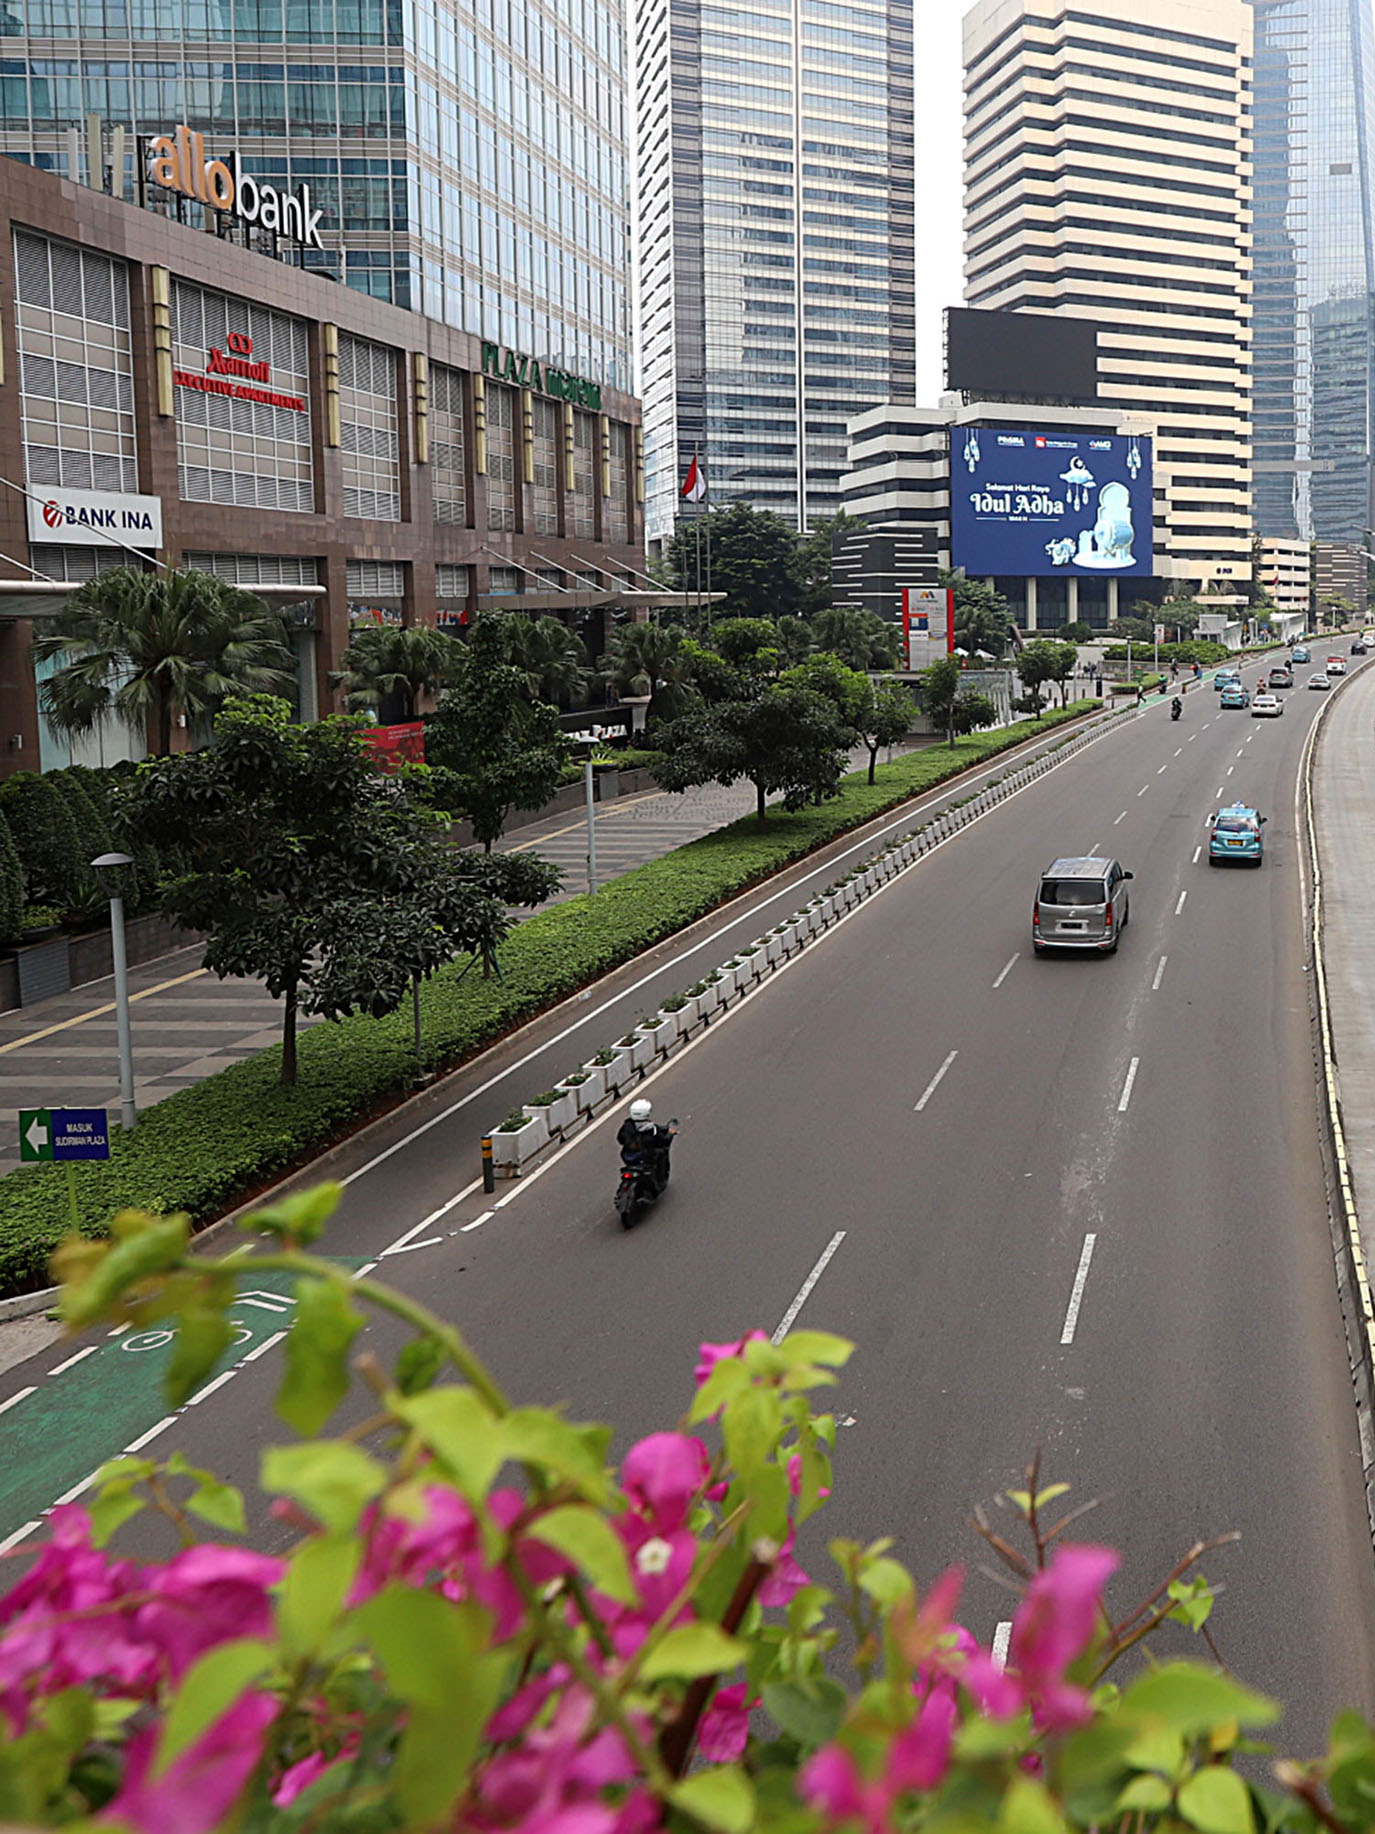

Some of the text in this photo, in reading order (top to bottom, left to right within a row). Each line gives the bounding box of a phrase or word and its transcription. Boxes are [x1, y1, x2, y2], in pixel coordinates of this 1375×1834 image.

[206, 347, 271, 383] Marriott
[480, 340, 544, 393] PLAZA
[173, 369, 305, 412] EXECUTIVE APARTMENTS
[65, 505, 153, 531] BANK INA
[969, 493, 1065, 516] Idul Adha
